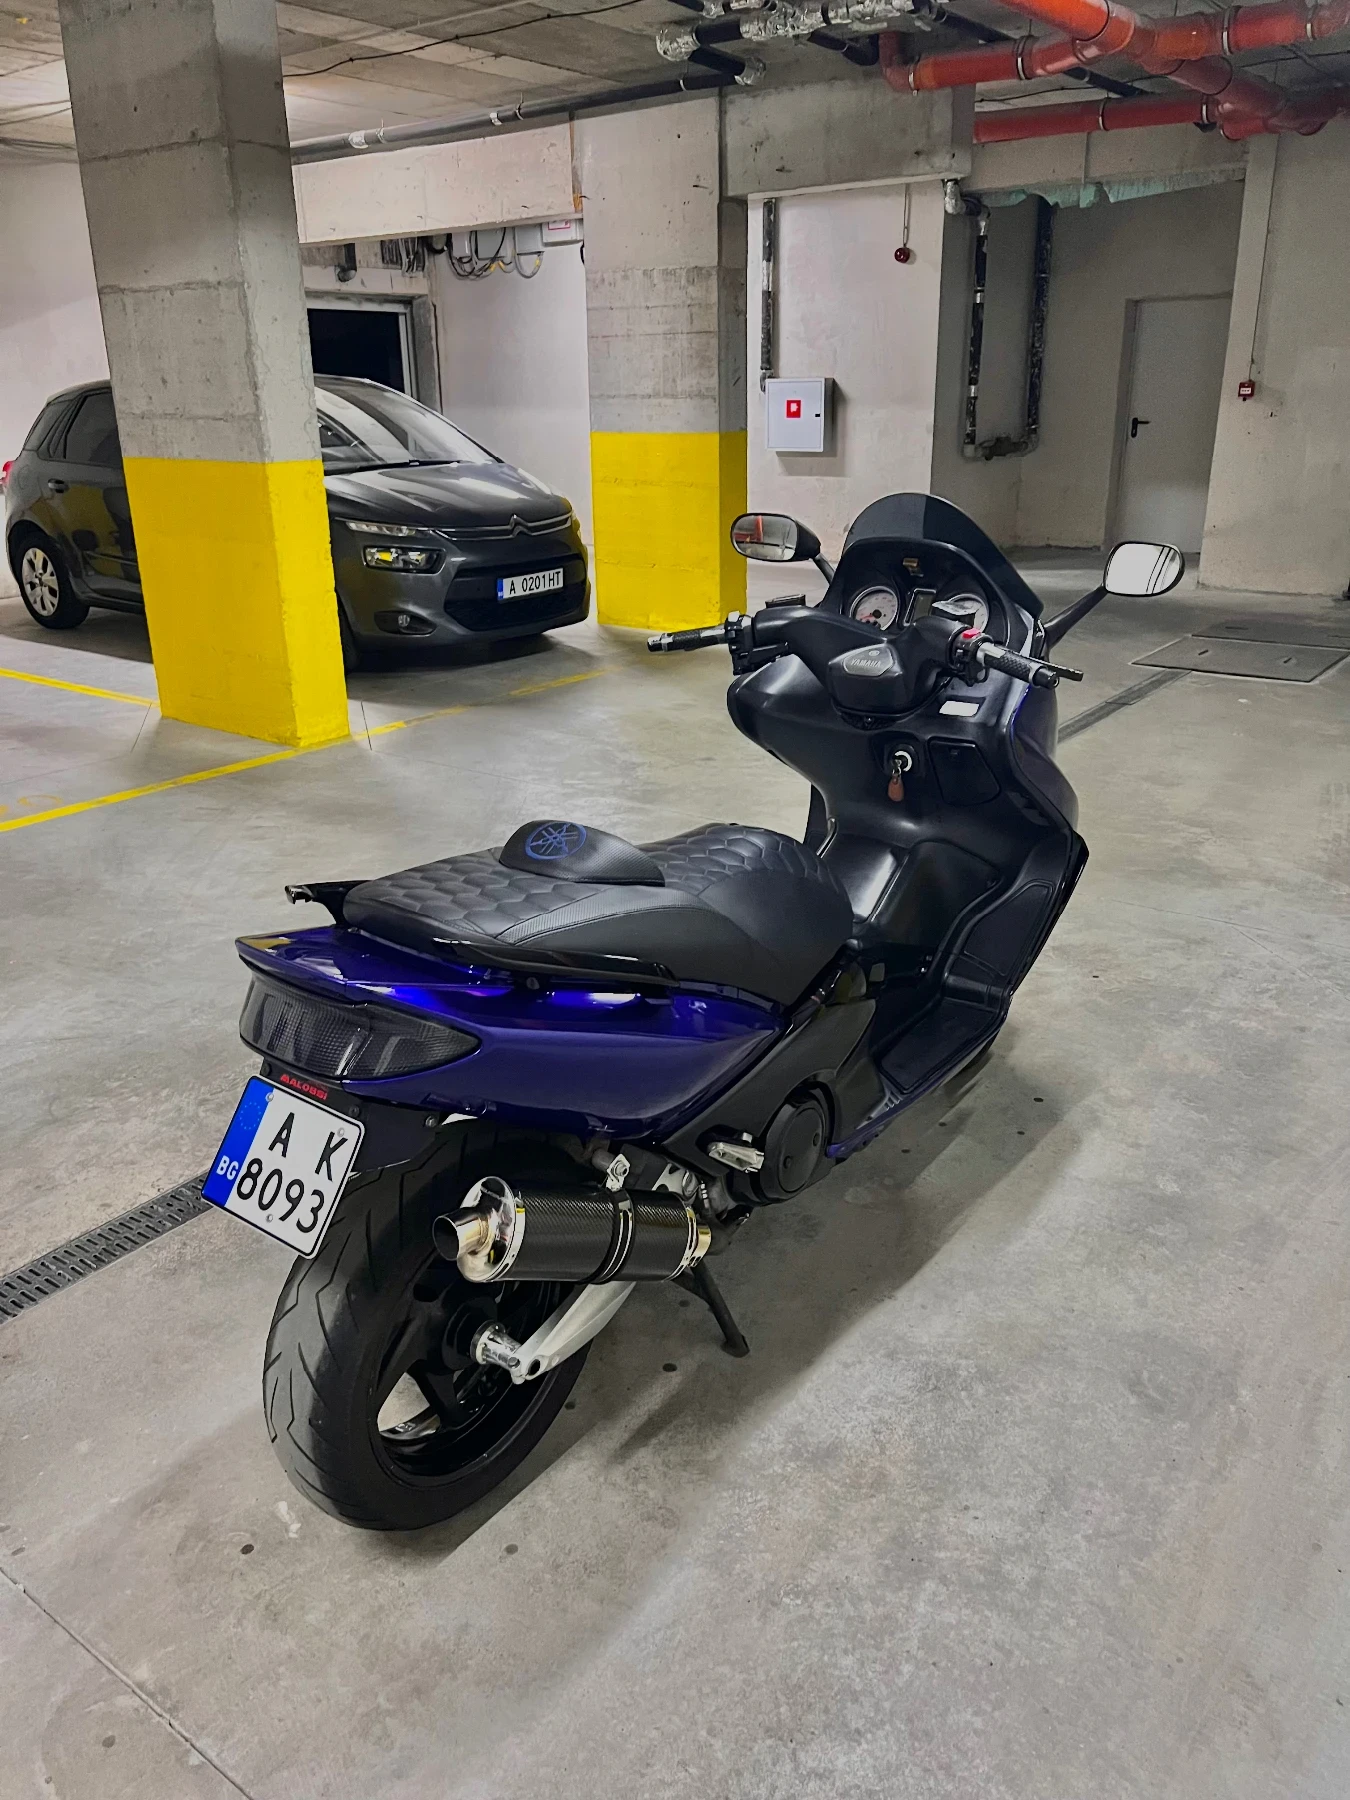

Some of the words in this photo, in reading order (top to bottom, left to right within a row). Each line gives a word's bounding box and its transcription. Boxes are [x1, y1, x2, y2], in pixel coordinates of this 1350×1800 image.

[509, 580, 516, 595] A
[850, 658, 881, 668] YAMAHA
[268, 1111, 295, 1158] A
[314, 1131, 348, 1182] K
[216, 1155, 239, 1180] BG
[236, 1157, 325, 1233] 8093
